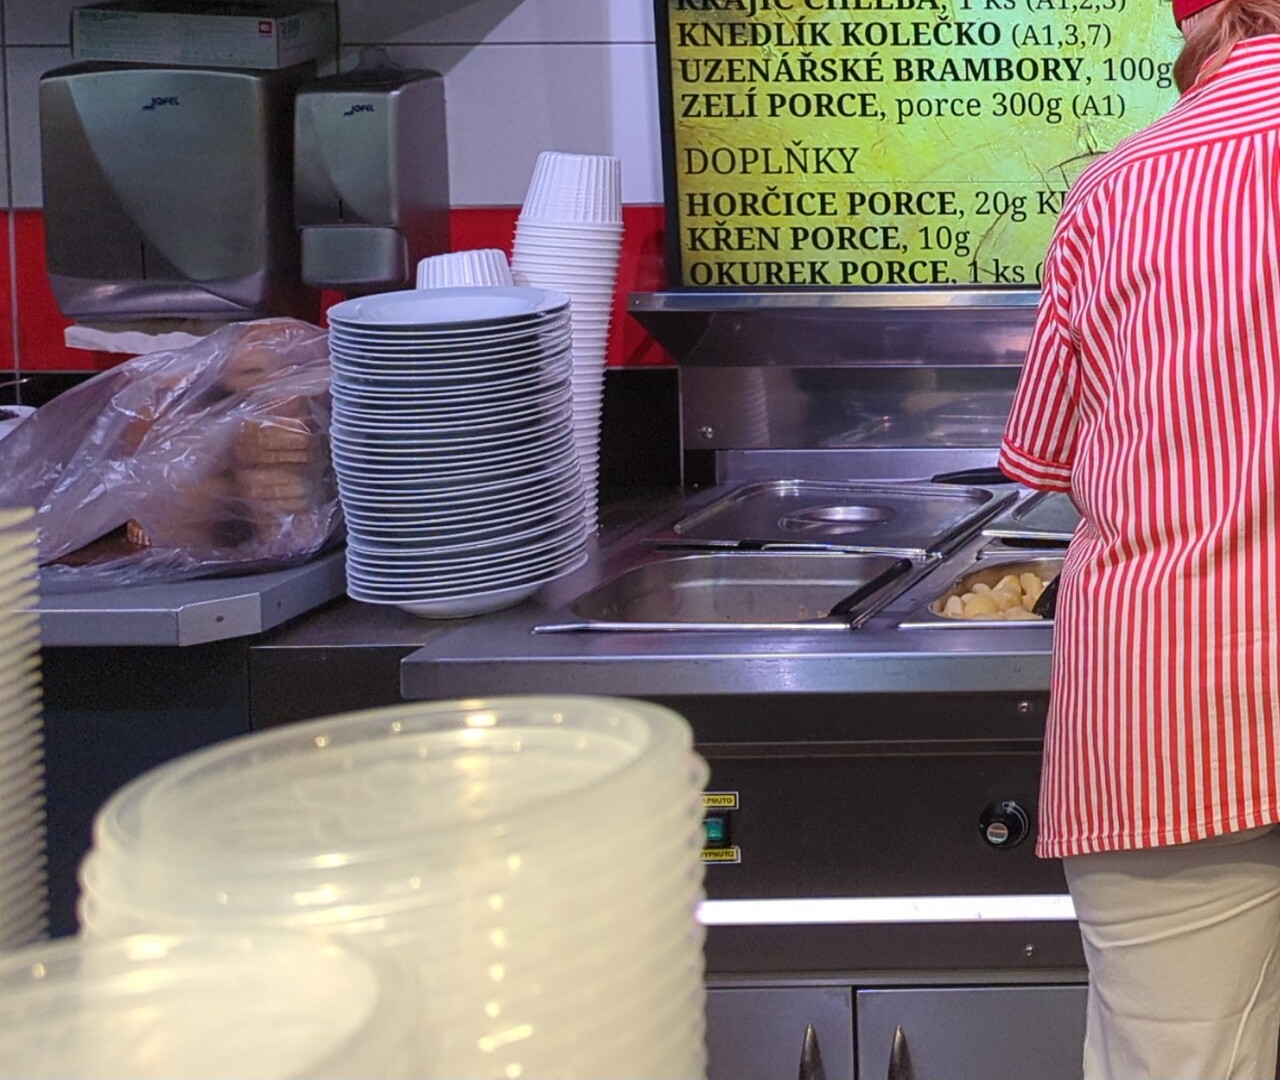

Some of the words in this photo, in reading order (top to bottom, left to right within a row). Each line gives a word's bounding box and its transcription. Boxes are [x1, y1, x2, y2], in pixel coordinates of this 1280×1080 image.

[678, 16, 831, 47] KNEDLÍK
[842, 14, 1001, 46] KOLEČKO
[1010, 23, 1112, 49] (A1,3,7)
[680, 52, 884, 83] UZENÁŘSKÉ
[893, 58, 1092, 85] BRAMBORY,
[1103, 58, 1173, 88] 100g
[681, 88, 757, 118] ZELÍ
[767, 93, 887, 122] PORCE,
[895, 97, 981, 125] porce
[991, 93, 1062, 124] 300g
[1071, 94, 1126, 119] (A1)
[685, 140, 859, 175] DOPLŇKY
[685, 186, 837, 217] HORČICE
[847, 192, 966, 220] PORCE,
[974, 192, 1027, 222] 20g
[688, 221, 781, 253] KŘEN
[790, 227, 908, 253] PORCE,
[918, 227, 971, 256] 10g
[689, 261, 830, 286] OKUREK
[968, 262, 980, 284] 1
[993, 260, 1025, 285] ks
